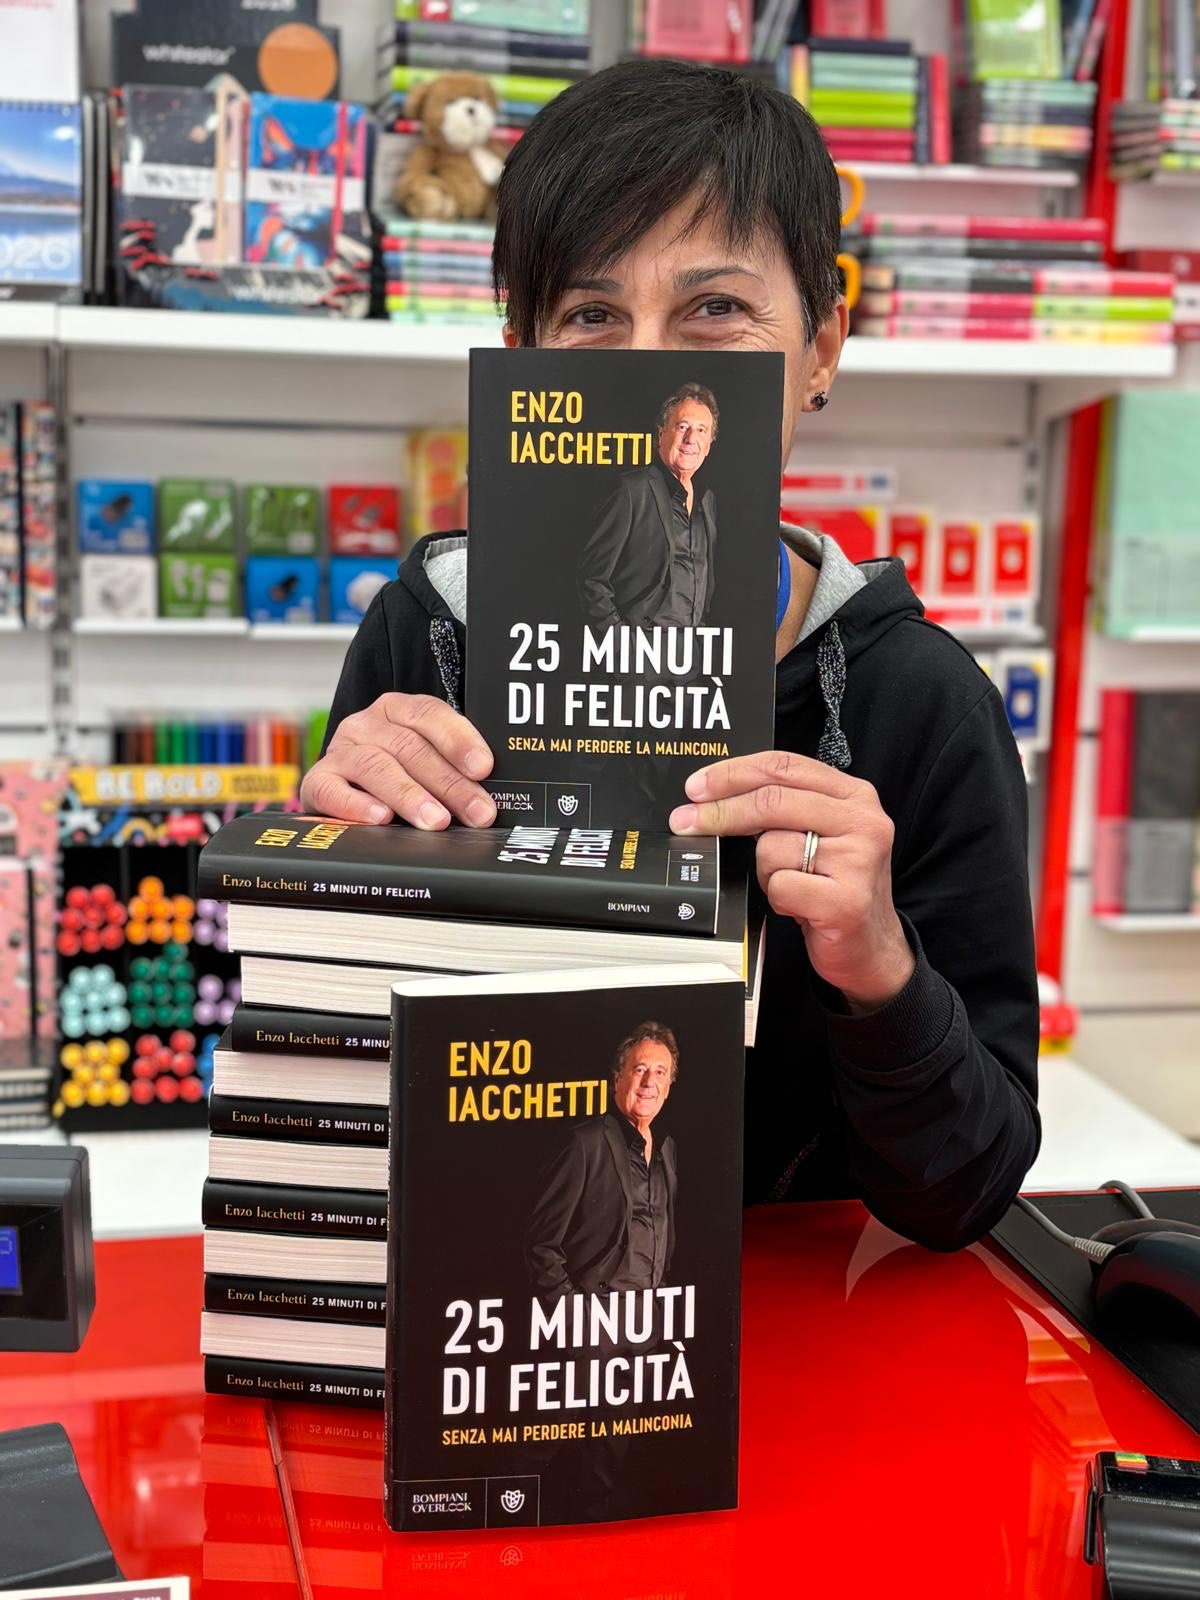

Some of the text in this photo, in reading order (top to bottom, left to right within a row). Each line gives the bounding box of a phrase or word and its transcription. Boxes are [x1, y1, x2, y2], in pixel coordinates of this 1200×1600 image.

[511, 391, 583, 424] ENZO
[511, 431, 652, 466] IACCHETTI
[509, 622, 733, 676] 25 MINUTI
[508, 676, 731, 730] DI FELICITÀ
[508, 737, 730, 757] SENZA MAI PERDERE LA MALINCONIA
[490, 792, 530, 802] OMPIANI
[496, 801, 534, 811] ERLOOK
[223, 874, 431, 900] Enzo Iacchetti 25 MINUTI DI FELICITÀ
[607, 902, 650, 913] BOMPIANI
[256, 1030, 390, 1049] Enzo Iacchetti 25 MINU
[450, 1039, 532, 1077] ENZO
[449, 1080, 607, 1122] IACCHETTI
[232, 1110, 385, 1132] Enzo Iacchetti 25 MINUTI DI
[225, 1203, 253, 1217] Enzo
[256, 1206, 305, 1221] Iacchetti
[311, 1212, 324, 1222] 25
[327, 1214, 363, 1225] MINUTI
[366, 1217, 377, 1226] DI
[227, 1288, 255, 1301] Enzo
[259, 1290, 307, 1305] Iacchetti
[312, 1297, 325, 1306] 25
[328, 1298, 364, 1309] MINUTI
[367, 1301, 378, 1310] DI
[445, 1285, 695, 1354] 25 MINUTI
[226, 1374, 254, 1387] Enzo
[257, 1376, 304, 1391] Iacchetti
[309, 1383, 322, 1393] 25
[325, 1384, 360, 1396] MINUTI
[363, 1388, 374, 1398] DI
[443, 1341, 694, 1415] DI FELICITÀ
[442, 1413, 693, 1446] SENZA MAI PERDERE LA MALINCONIA
[411, 1502, 472, 1514] OVERLOOK
[412, 1492, 468, 1504] BOMPIANI
